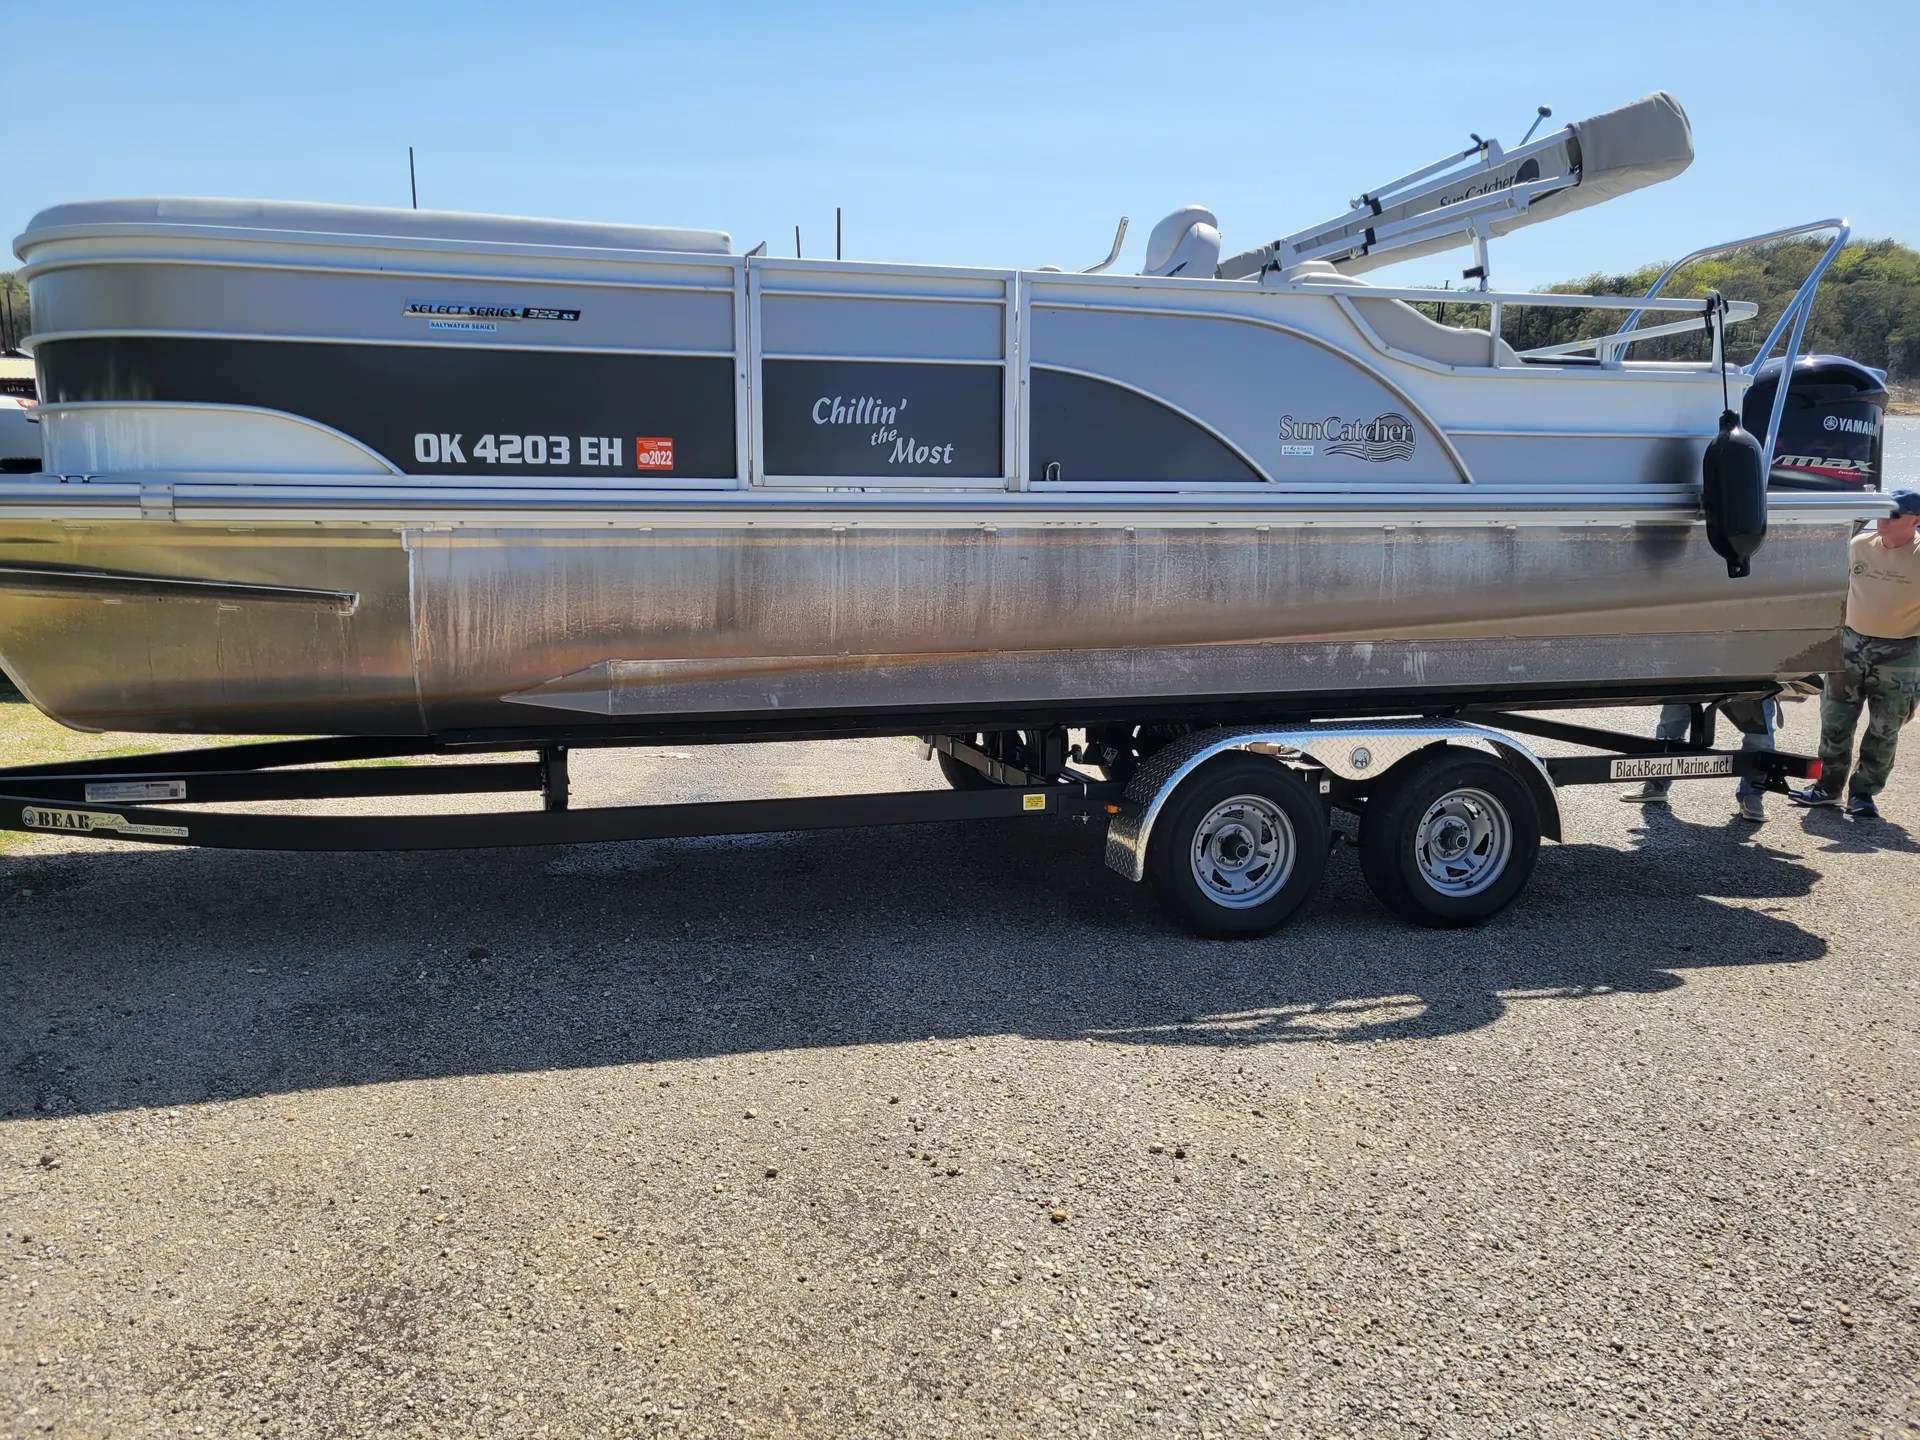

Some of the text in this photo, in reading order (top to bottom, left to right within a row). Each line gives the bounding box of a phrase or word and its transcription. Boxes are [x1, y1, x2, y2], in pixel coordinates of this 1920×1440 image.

[410, 303, 465, 315] SELECT
[468, 306, 519, 318] SERIES
[527, 309, 560, 319] 322
[812, 396, 908, 425] Chillin'
[871, 426, 898, 446] the
[1279, 414, 1411, 442] SunCatcher
[1839, 417, 1877, 437] YAMAHA
[414, 433, 623, 466] OK 4203 EH
[649, 450, 672, 465] 2022
[888, 437, 954, 464] Most
[1615, 757, 1730, 778] BlackBeard Marine.net
[37, 811, 90, 830] BEAR
